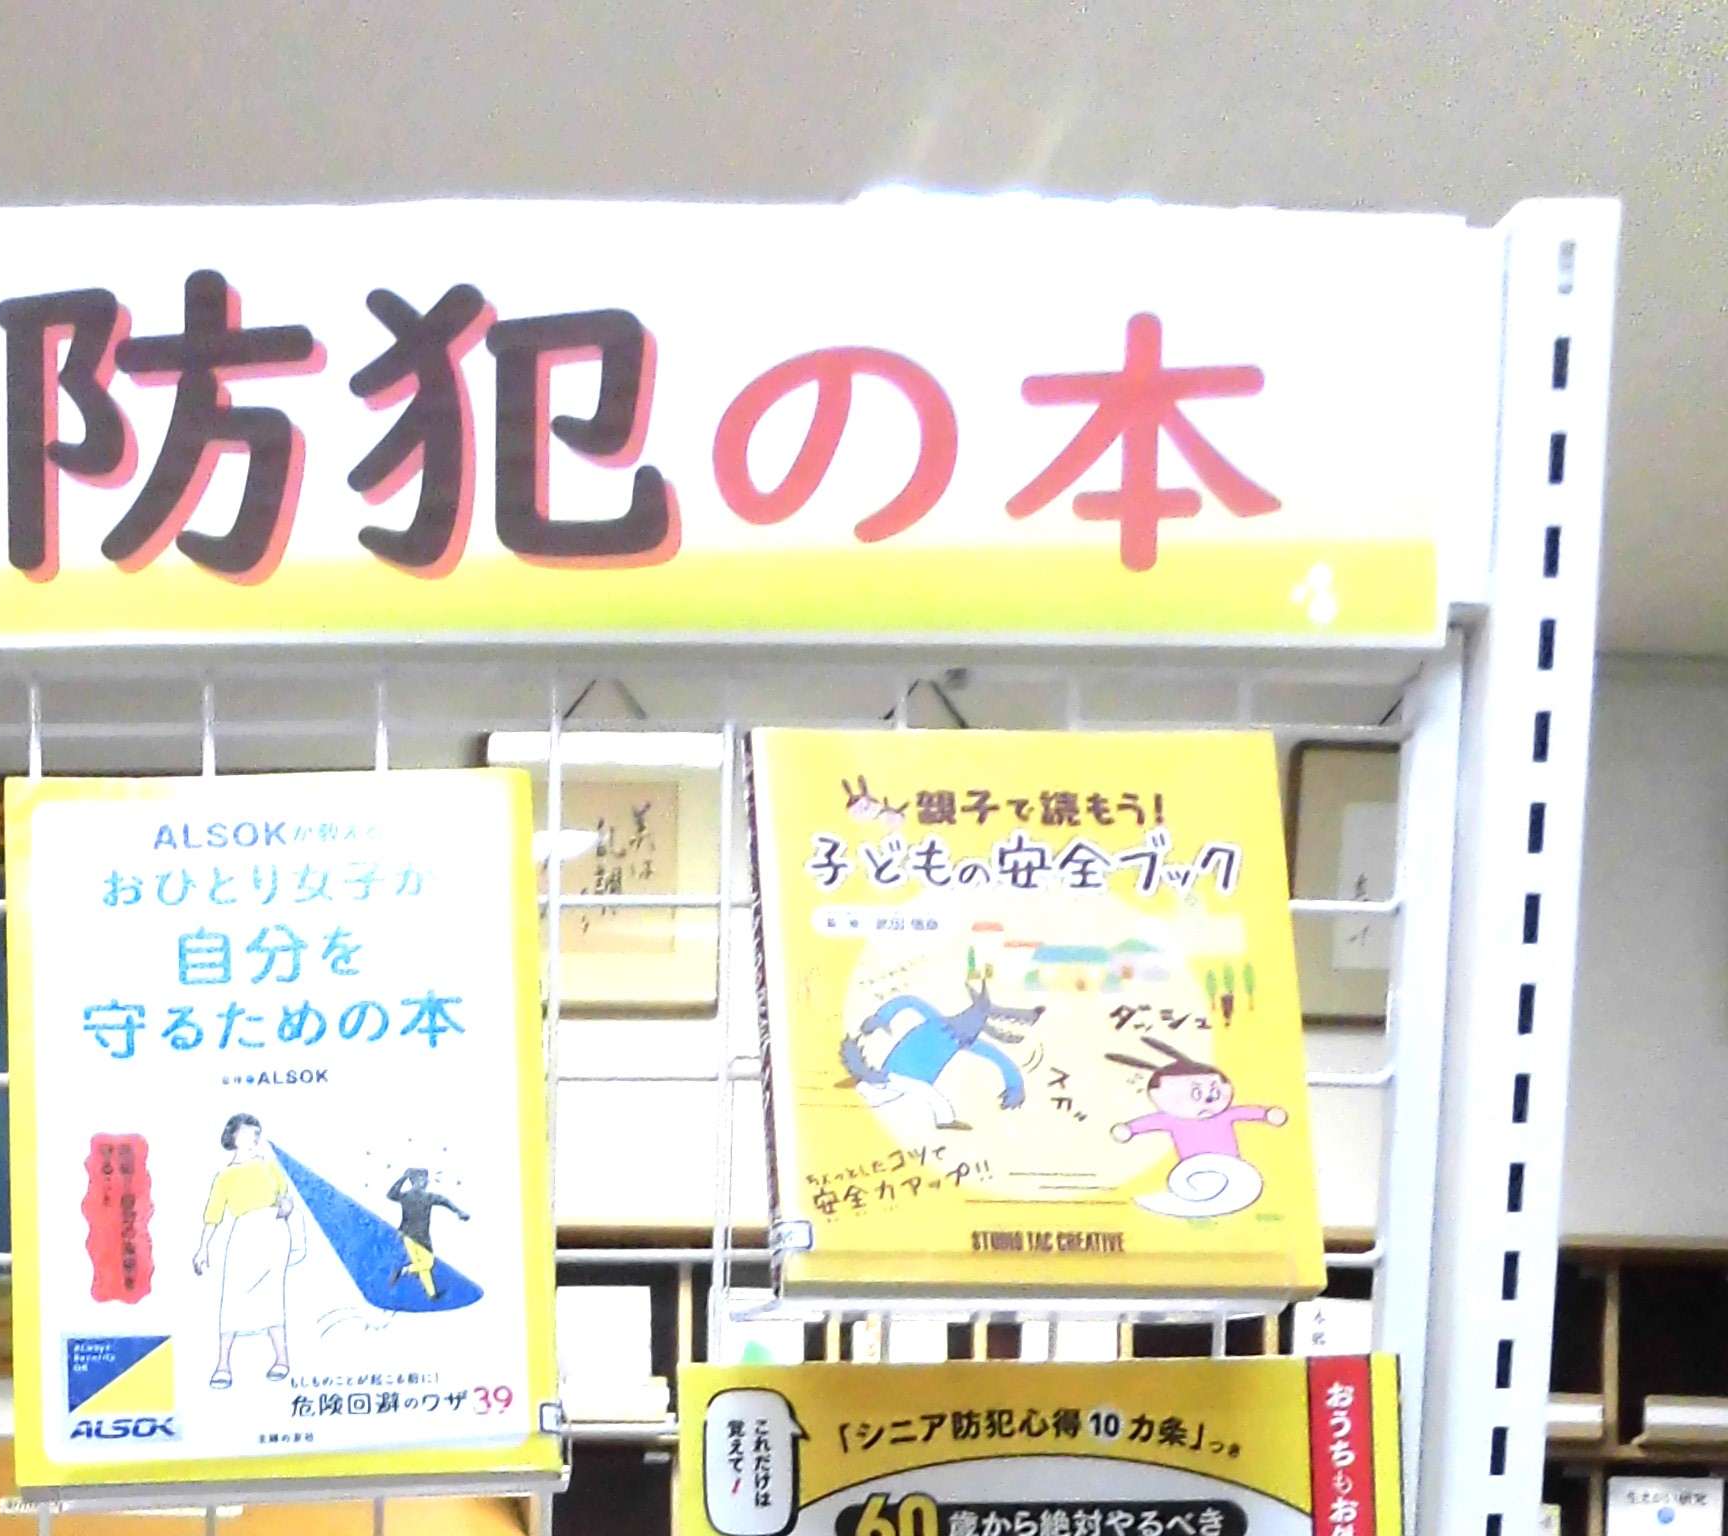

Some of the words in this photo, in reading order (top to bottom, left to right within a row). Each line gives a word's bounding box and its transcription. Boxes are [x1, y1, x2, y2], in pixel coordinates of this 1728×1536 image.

[916, 790, 1165, 826] 親子で読もう!
[102, 863, 436, 906] おひとり女子が
[810, 834, 1237, 891] 子どもの安全ブック
[177, 924, 361, 985] 自分を
[83, 989, 465, 1059] 守るための本
[257, 1069, 328, 1086] ALSOK
[972, 1230, 1022, 1251] STUDIO
[1027, 1230, 1054, 1251] TAC
[1057, 1230, 1124, 1251] CREATIVE
[70, 1417, 175, 1440] ALSOK
[726, 1419, 745, 1495] 覚えて!
[753, 1418, 772, 1508] これだけは
